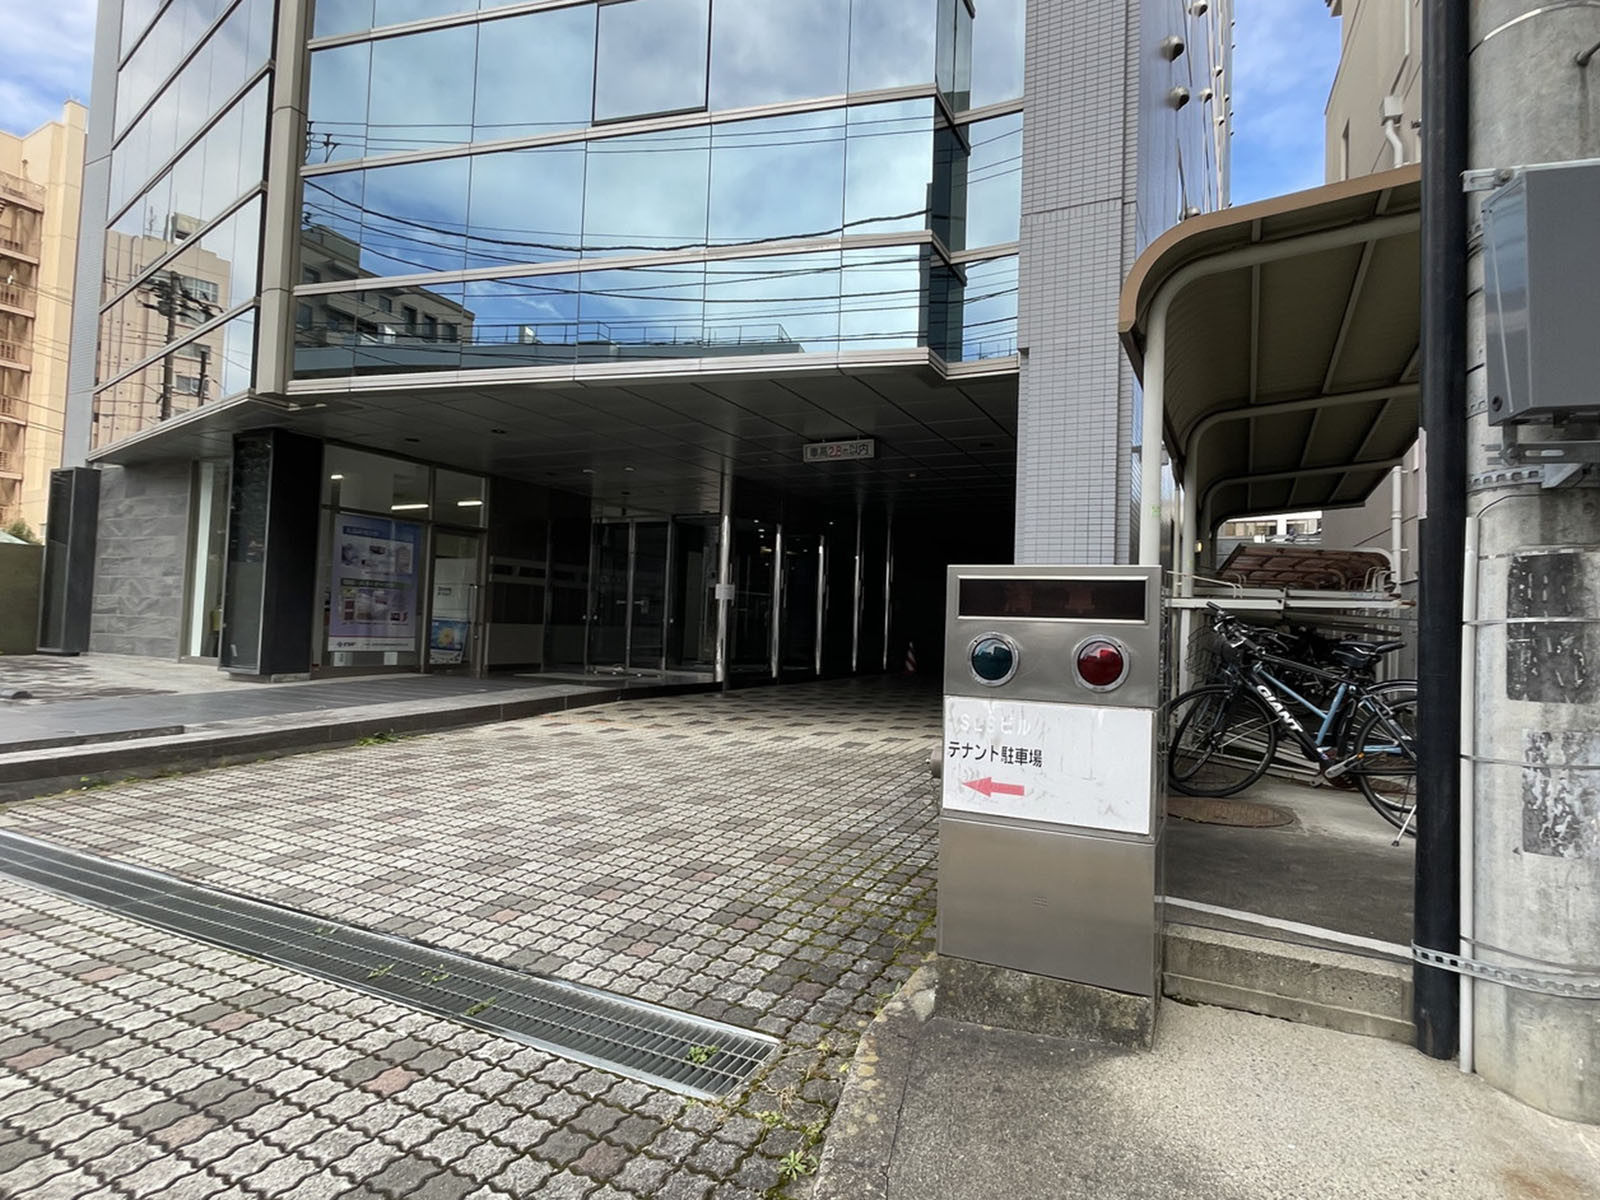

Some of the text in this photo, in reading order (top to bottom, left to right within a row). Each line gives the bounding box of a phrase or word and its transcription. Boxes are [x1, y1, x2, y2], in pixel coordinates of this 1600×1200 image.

[1257, 685, 1304, 732] GIANT
[948, 741, 1042, 768] テナント駐車場
